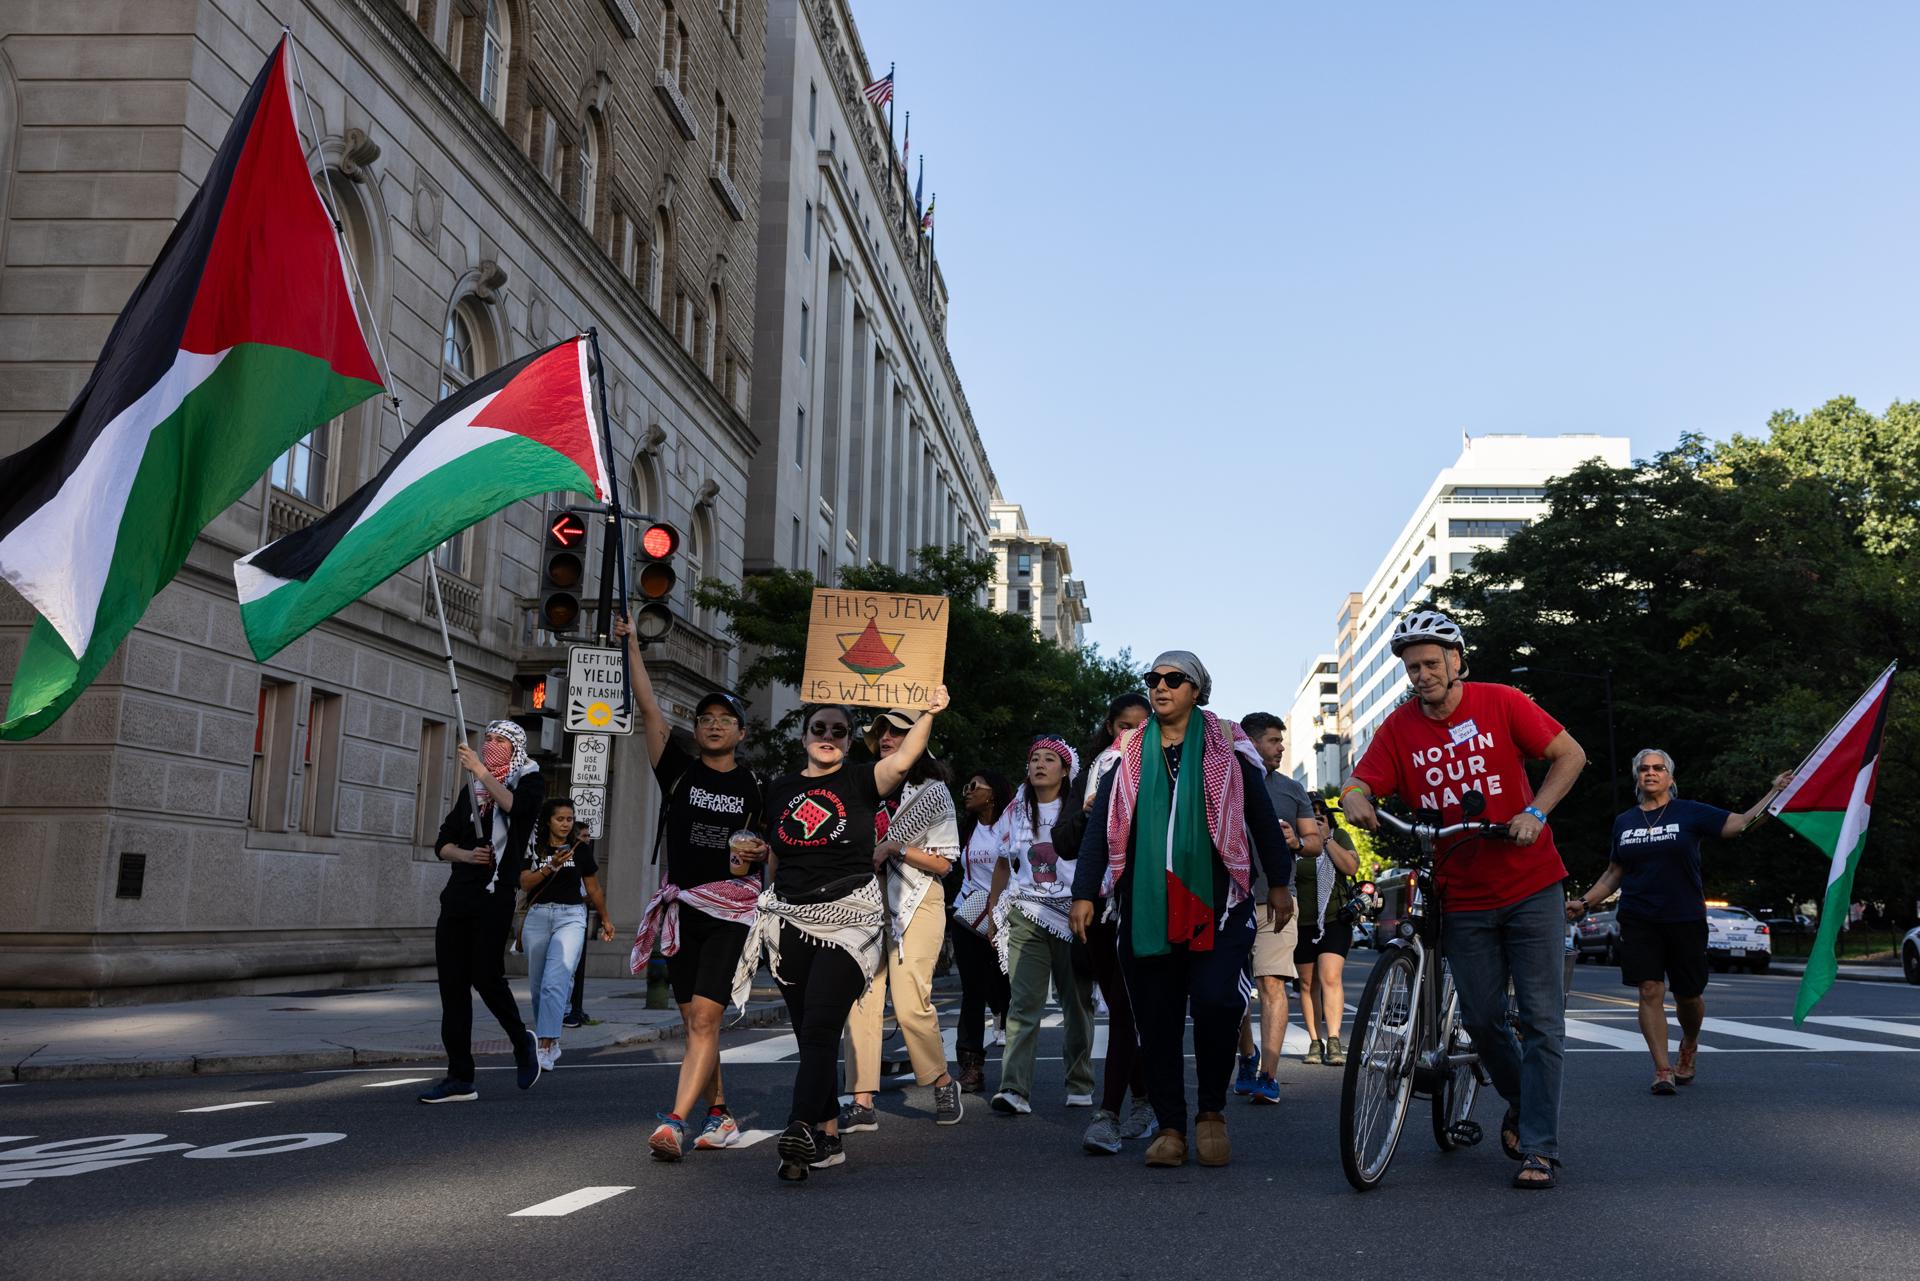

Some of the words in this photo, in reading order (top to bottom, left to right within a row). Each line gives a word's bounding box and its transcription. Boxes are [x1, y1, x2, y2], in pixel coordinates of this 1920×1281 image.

[817, 594, 879, 620] THIS
[888, 596, 945, 621] JEW
[577, 653, 601, 664] LEFT
[603, 655, 623, 667] TUR
[584, 668, 622, 684] YIELD
[569, 686, 582, 696] ON
[587, 687, 624, 700] FLASHIN
[811, 680, 831, 700] IS
[838, 681, 900, 704] WITH
[1412, 742, 1456, 768] NOT
[1468, 732, 1494, 752] IN
[576, 773, 601, 781] SIGNAL
[583, 764, 597, 772] PED
[1425, 754, 1487, 787] OUR
[690, 786, 744, 807] RESEARCH
[1420, 774, 1503, 811] NAME
[576, 808, 597, 816] YIELD
[788, 792, 807, 809] FOR
[807, 788, 847, 817] CEASEFIRE
[829, 818, 848, 840] NOW
[968, 857, 993, 865] SRAEL
